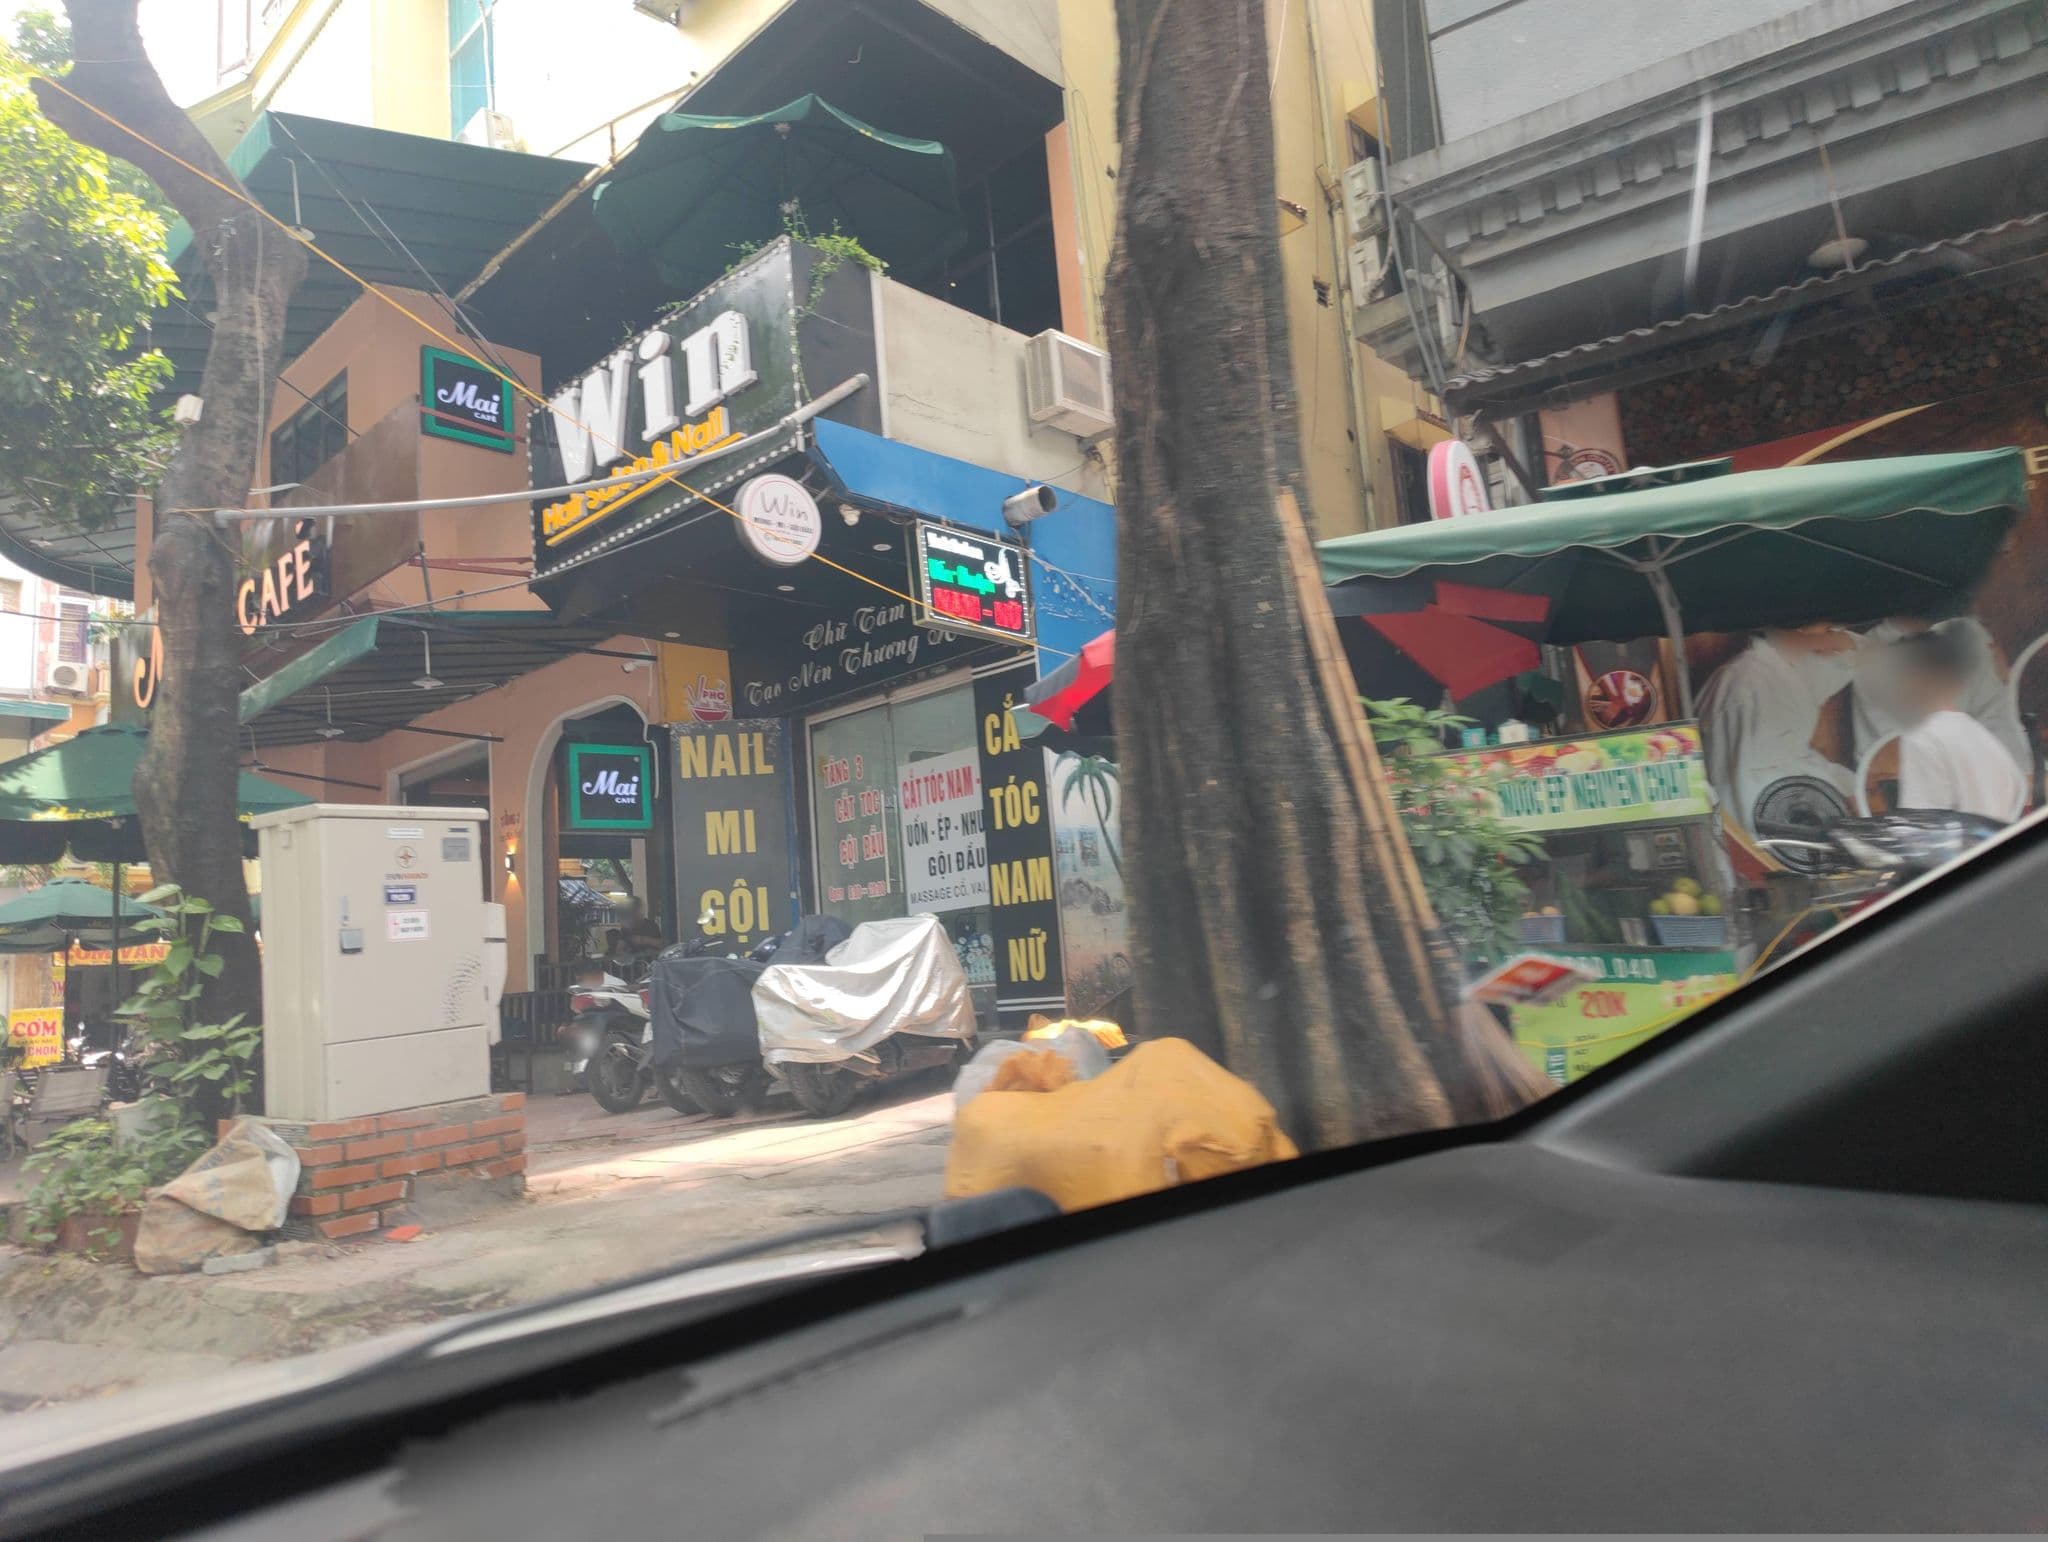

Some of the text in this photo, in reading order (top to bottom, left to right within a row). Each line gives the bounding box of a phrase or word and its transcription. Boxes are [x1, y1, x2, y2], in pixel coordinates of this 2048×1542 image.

[437, 381, 501, 415] Mai
[549, 311, 758, 486] Win
[543, 493, 586, 535] Hair
[672, 406, 730, 460] Nail
[761, 491, 809, 521] Win
[238, 520, 314, 635] CAFÉ
[853, 604, 905, 634] Tâm
[984, 693, 1021, 756] CẢ
[680, 732, 774, 779] NAIL
[855, 754, 864, 782] 3
[582, 770, 639, 796] Mai
[922, 767, 945, 803] TÓC
[946, 765, 974, 800] NAM
[989, 775, 1040, 830] TÓC
[705, 809, 756, 855] MI
[928, 841, 985, 879] GỘI ĐẦU
[990, 856, 1053, 907] NAM
[700, 878, 770, 943] GỘI
[910, 886, 952, 905] MASSAGE
[1008, 927, 1048, 982] NỮ
